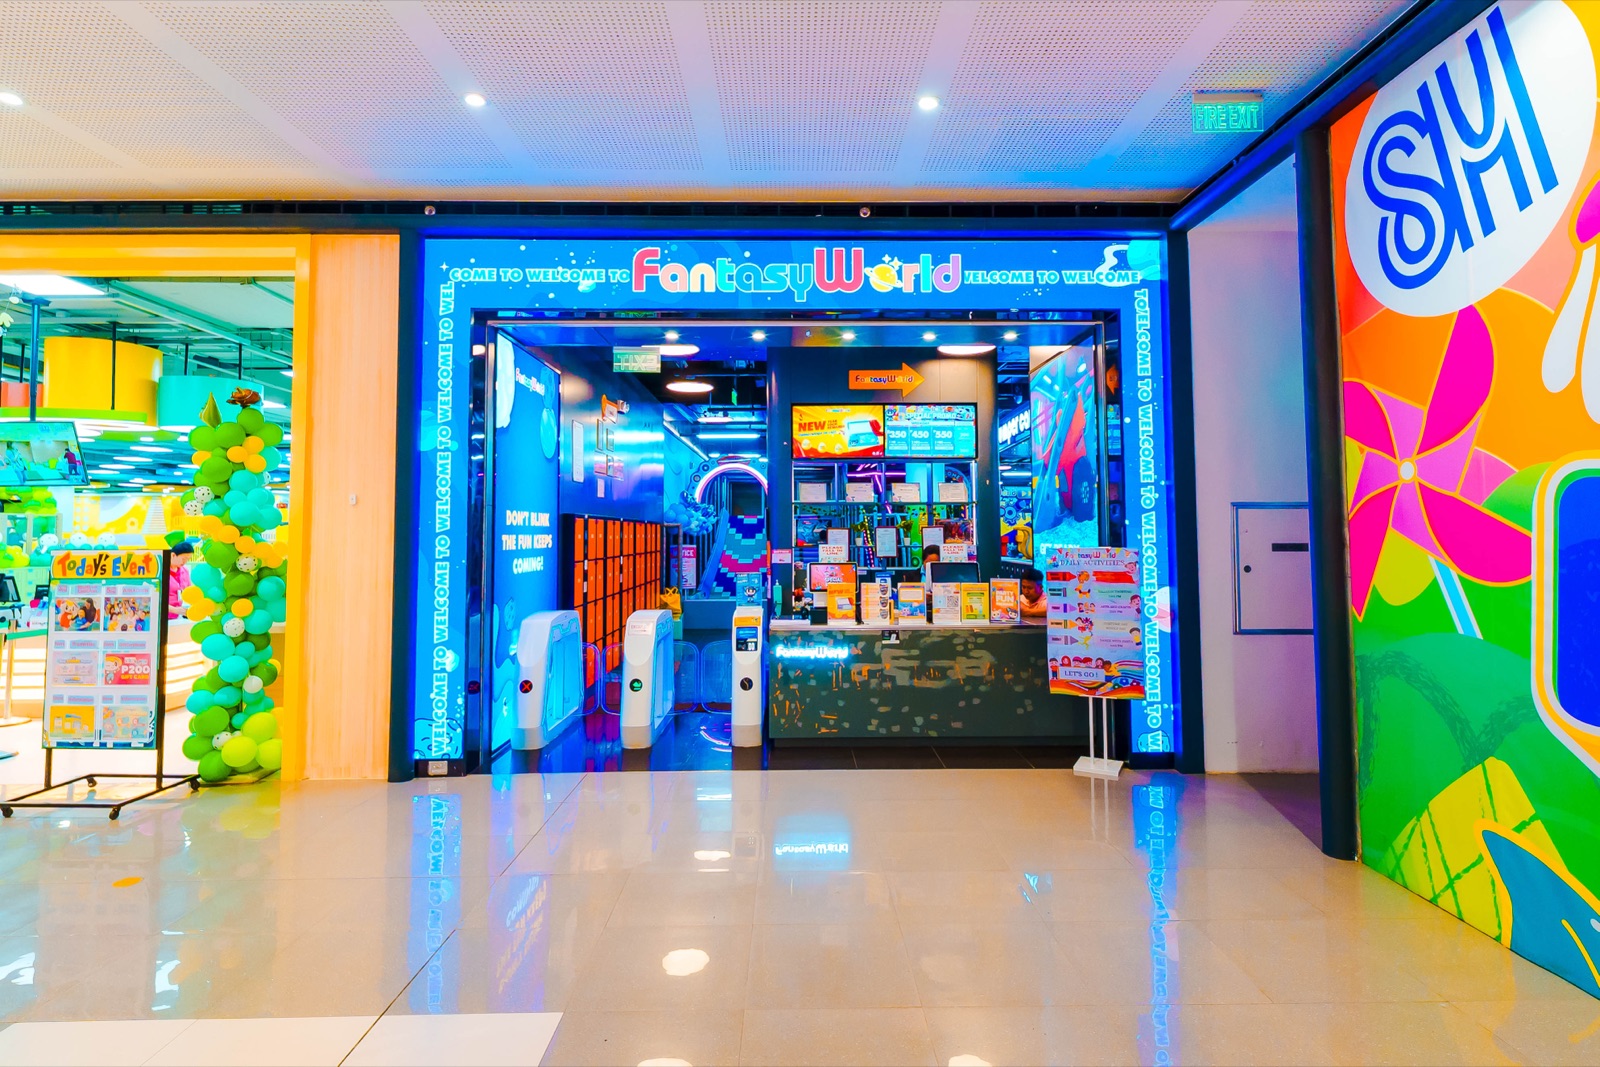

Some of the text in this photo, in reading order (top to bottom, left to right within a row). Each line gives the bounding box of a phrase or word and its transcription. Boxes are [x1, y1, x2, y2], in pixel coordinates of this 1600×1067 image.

[1195, 105, 1259, 129] FIRE EXIT
[1363, 5, 1559, 290] SM
[449, 267, 631, 283] COME TO WELCOME TO
[632, 247, 962, 303] FantasyWorld
[1036, 270, 1060, 284] TO
[1061, 270, 1141, 285] WELCOME
[1134, 289, 1149, 310] TO
[1138, 379, 1152, 402] TO
[798, 421, 826, 432] NEW
[1139, 404, 1154, 483] WELCOME
[1141, 486, 1155, 509] TO
[432, 281, 454, 756] WELCOME TO WELCOME TO WELCOME TO WELCOME TO WEL
[506, 510, 529, 526] DON'T
[502, 534, 553, 551] THE FUN KEEPS
[1142, 511, 1157, 591] WELCOME
[58, 552, 152, 576] Today's Event
[512, 556, 544, 575] COMING!
[1144, 595, 1158, 618] TO
[121, 665, 150, 674] P200
[1145, 621, 1161, 700] WELCOME
[1147, 704, 1162, 728] TO
